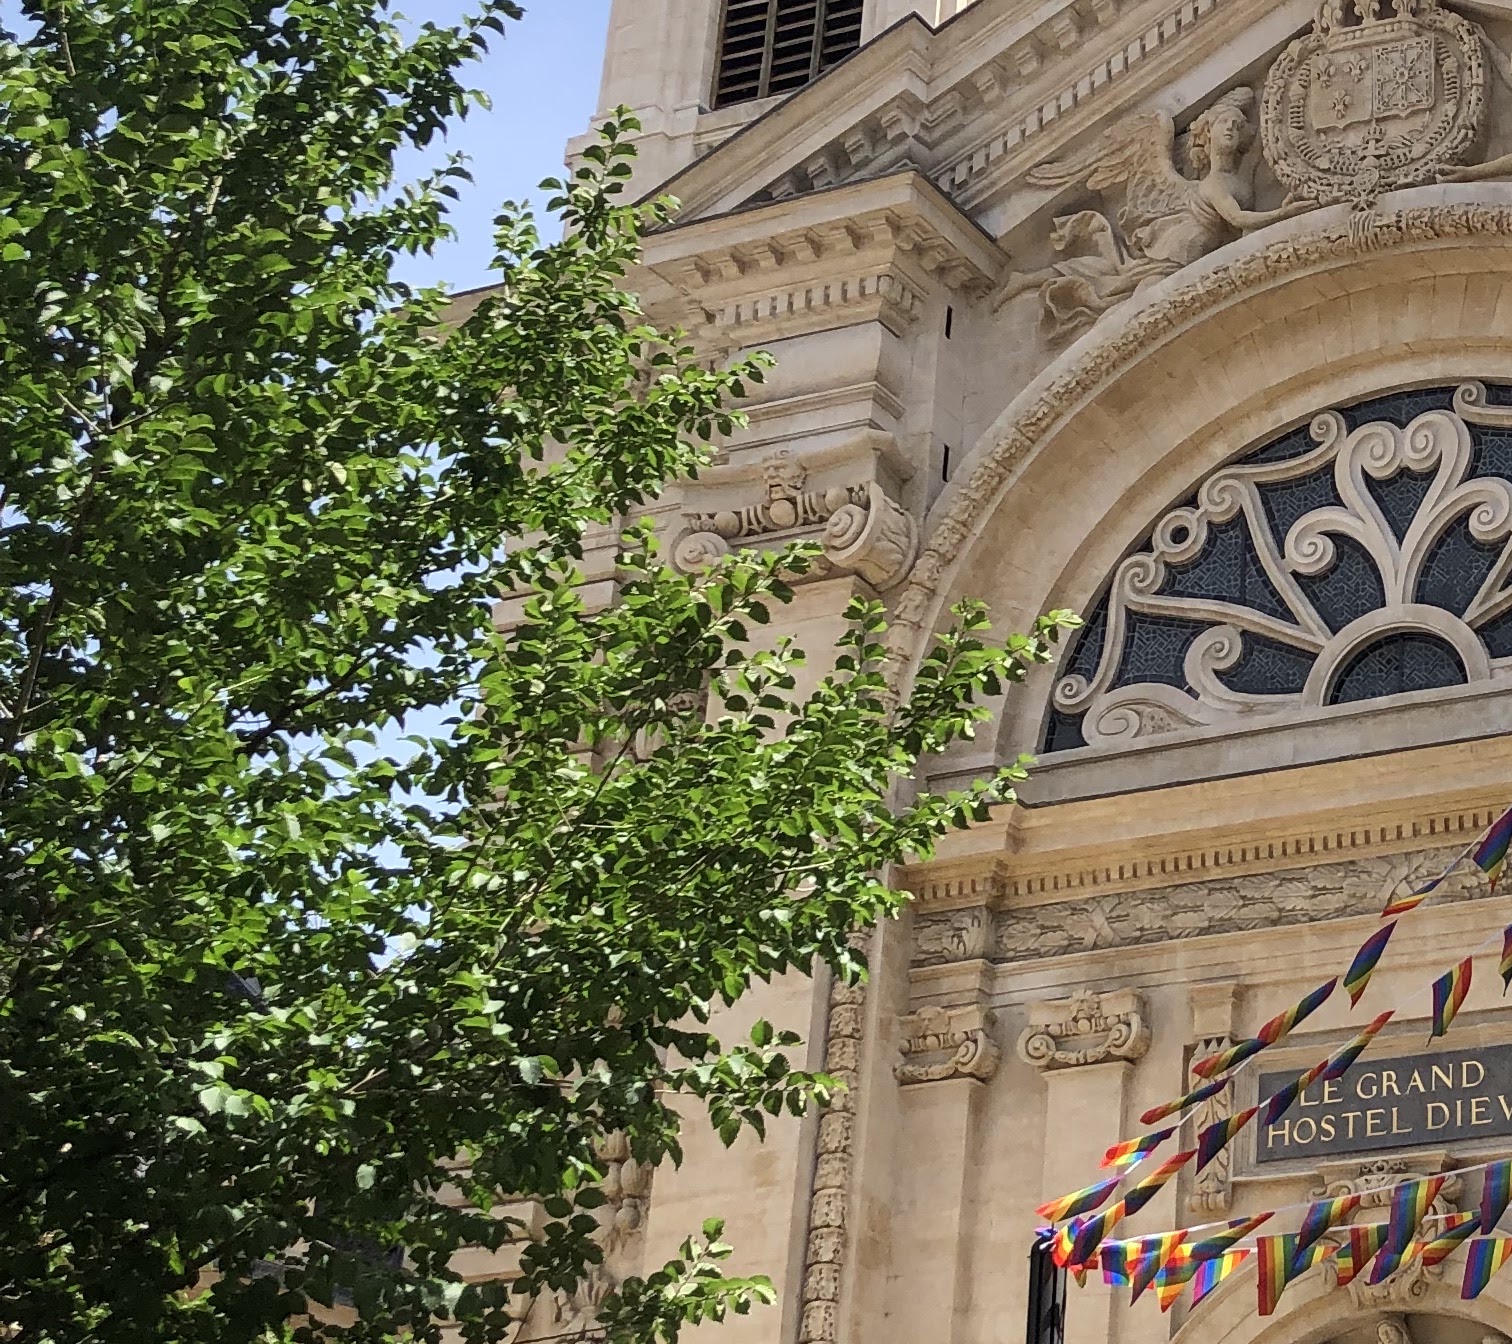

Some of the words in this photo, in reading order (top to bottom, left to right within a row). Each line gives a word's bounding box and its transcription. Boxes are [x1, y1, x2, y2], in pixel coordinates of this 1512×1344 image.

[1299, 1077, 1344, 1107] LE
[1356, 1060, 1486, 1100] GRAND
[1267, 1107, 1413, 1148] HOSTEL
